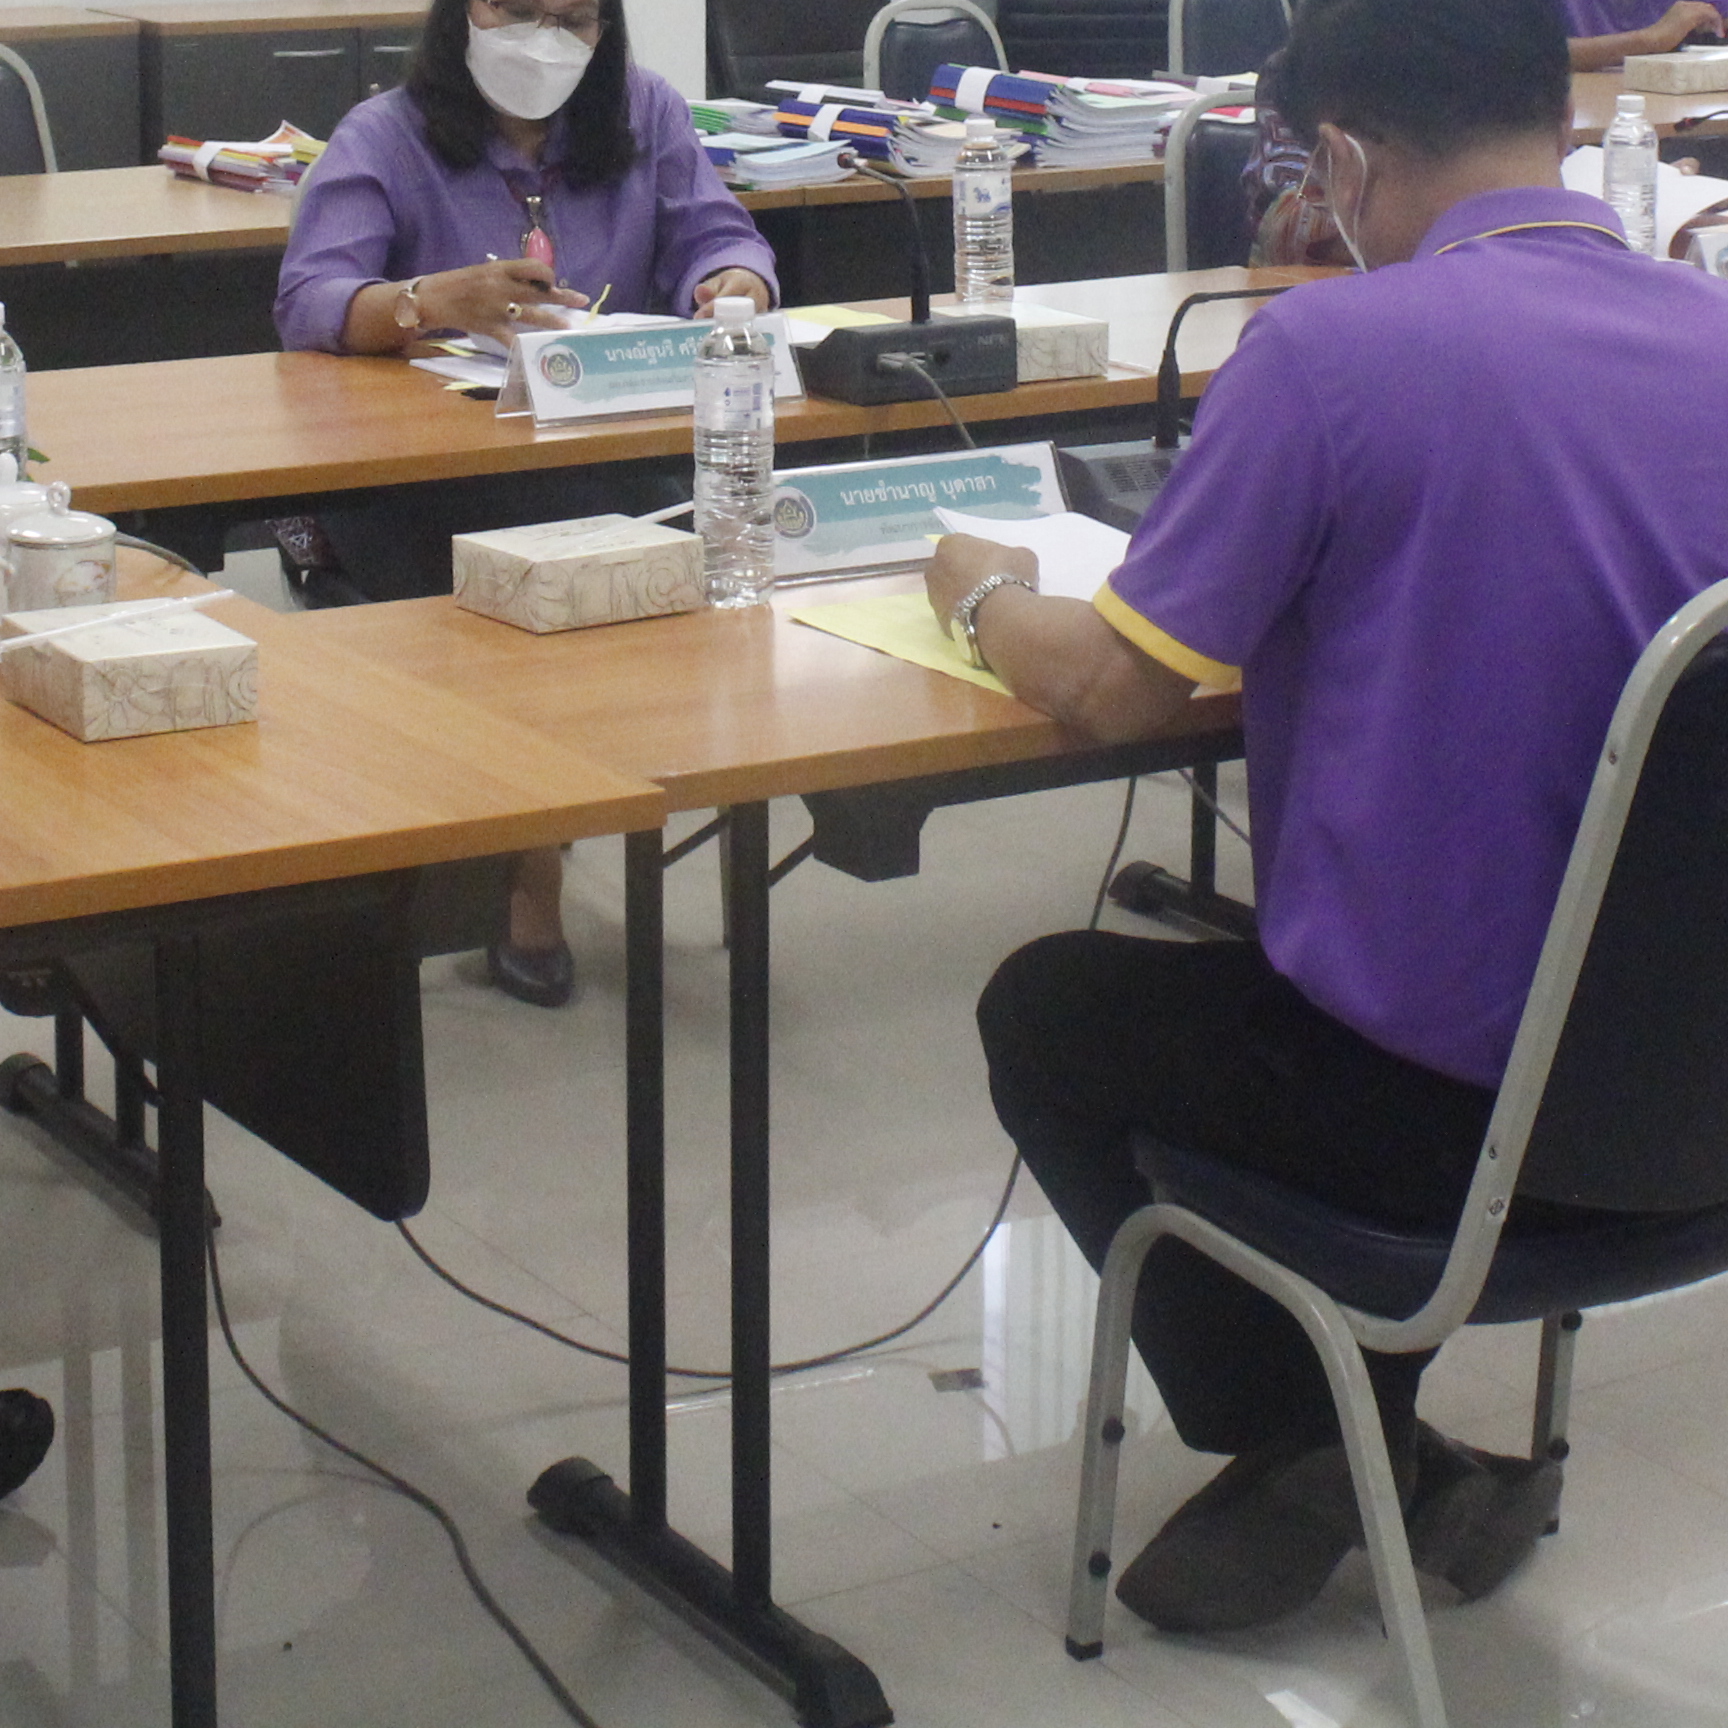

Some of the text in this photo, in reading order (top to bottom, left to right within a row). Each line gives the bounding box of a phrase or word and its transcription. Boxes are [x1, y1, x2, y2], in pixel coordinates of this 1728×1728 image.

[840, 474, 997, 507] นายชำนาญ บุดาสา
